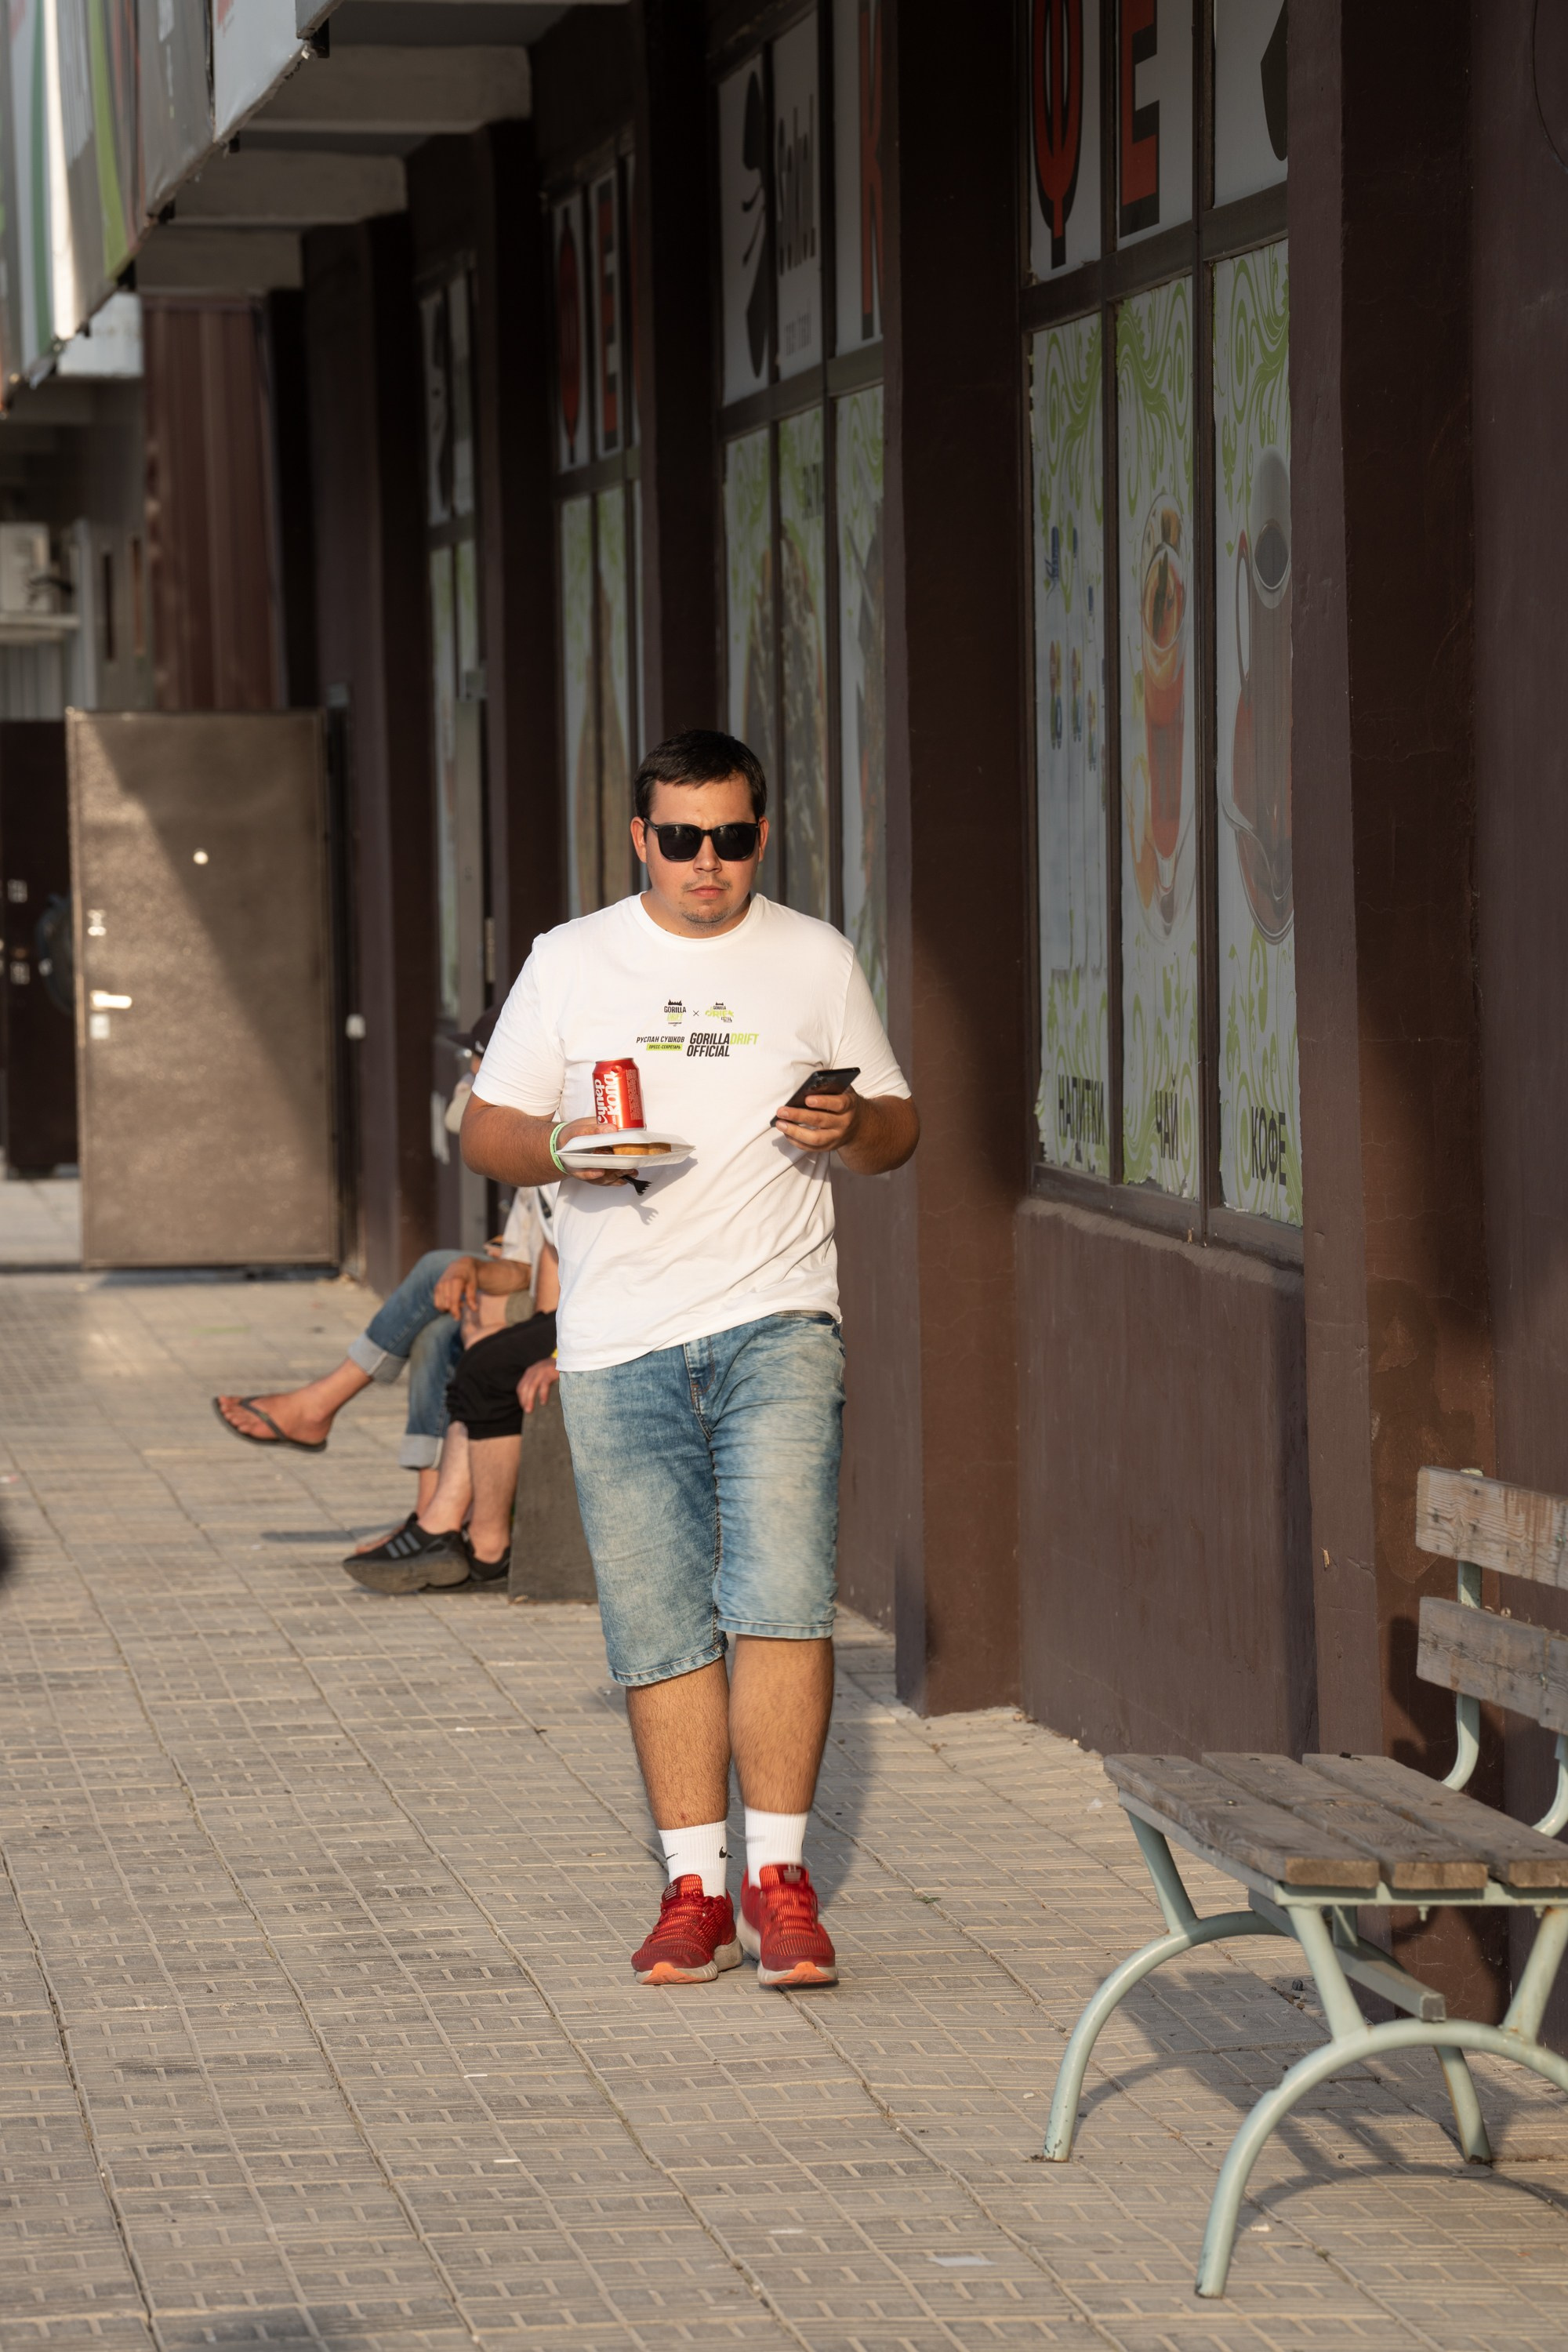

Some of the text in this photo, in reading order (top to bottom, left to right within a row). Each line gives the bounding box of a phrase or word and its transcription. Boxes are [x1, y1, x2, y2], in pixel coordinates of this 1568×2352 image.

[687, 1045, 730, 1057] OFFICIAL
[1058, 1075, 1105, 1145] НАПИТКИ
[1155, 1073, 1178, 1161] ЧАЙ
[1251, 1106, 1286, 1186] КОФЕ
